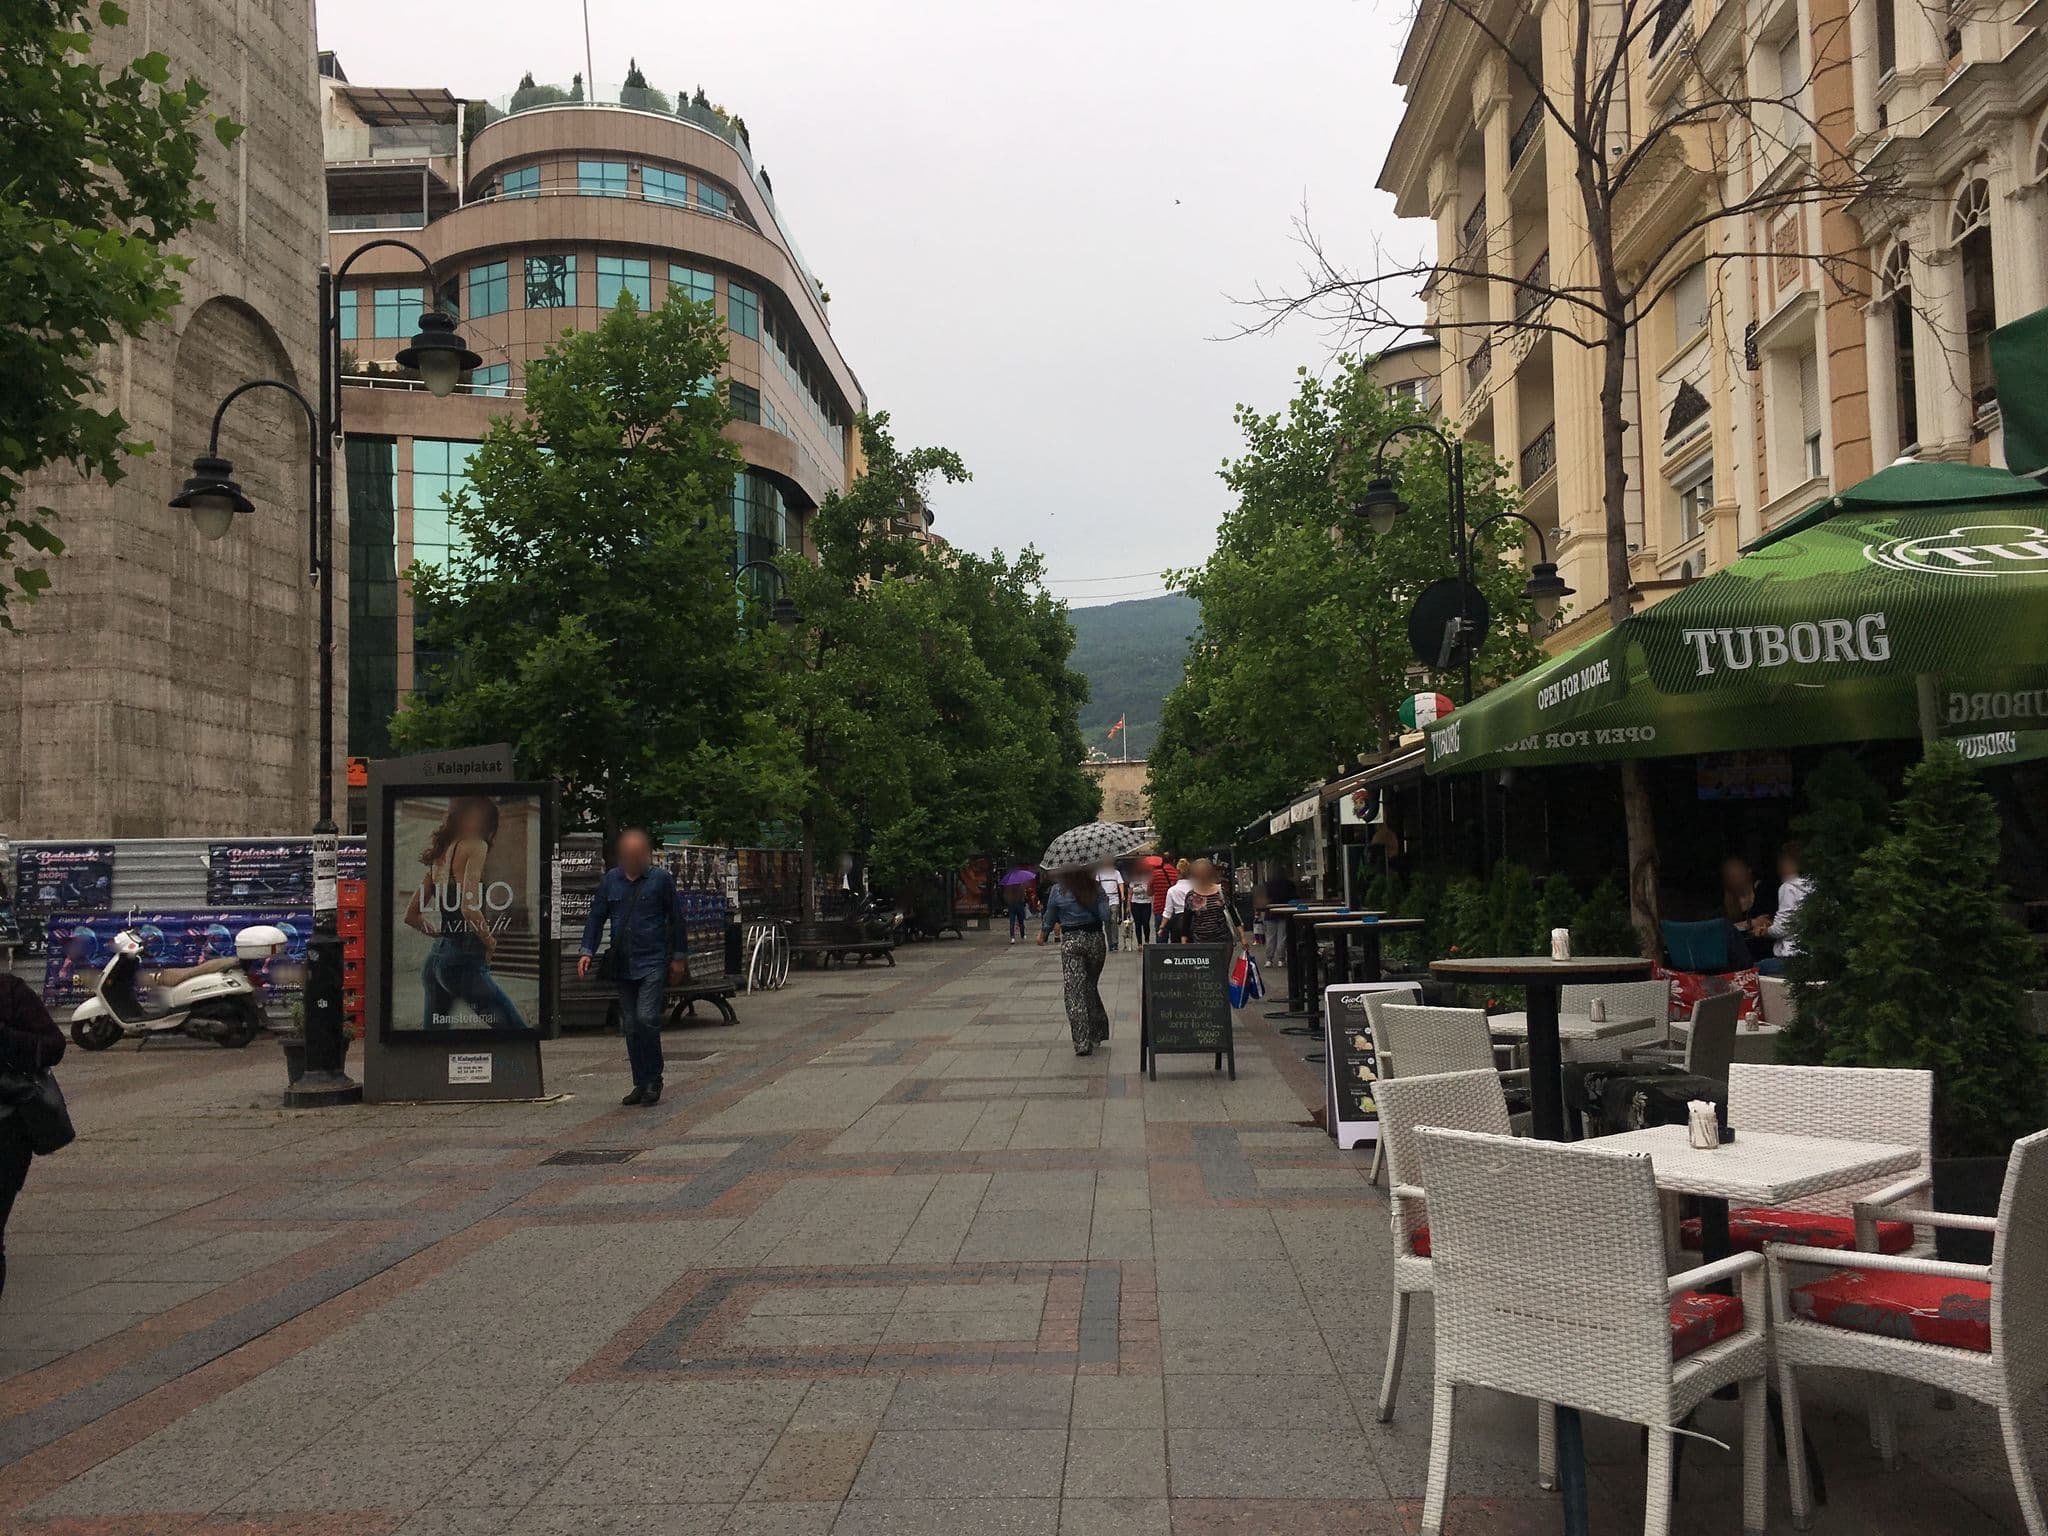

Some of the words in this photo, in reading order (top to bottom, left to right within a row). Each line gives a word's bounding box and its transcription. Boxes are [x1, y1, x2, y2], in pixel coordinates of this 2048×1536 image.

[1682, 612, 1890, 676] TUBORG
[1538, 681, 1561, 711] OPEN
[1561, 673, 1579, 700] FOR
[1581, 659, 1611, 692] MORE
[1431, 719, 1462, 763] TUBORG
[436, 760, 502, 776] Kalaplakat
[38, 872, 69, 880] SKOPJE
[1173, 957, 1197, 965] ZLATEN
[1197, 957, 1210, 965] DAB
